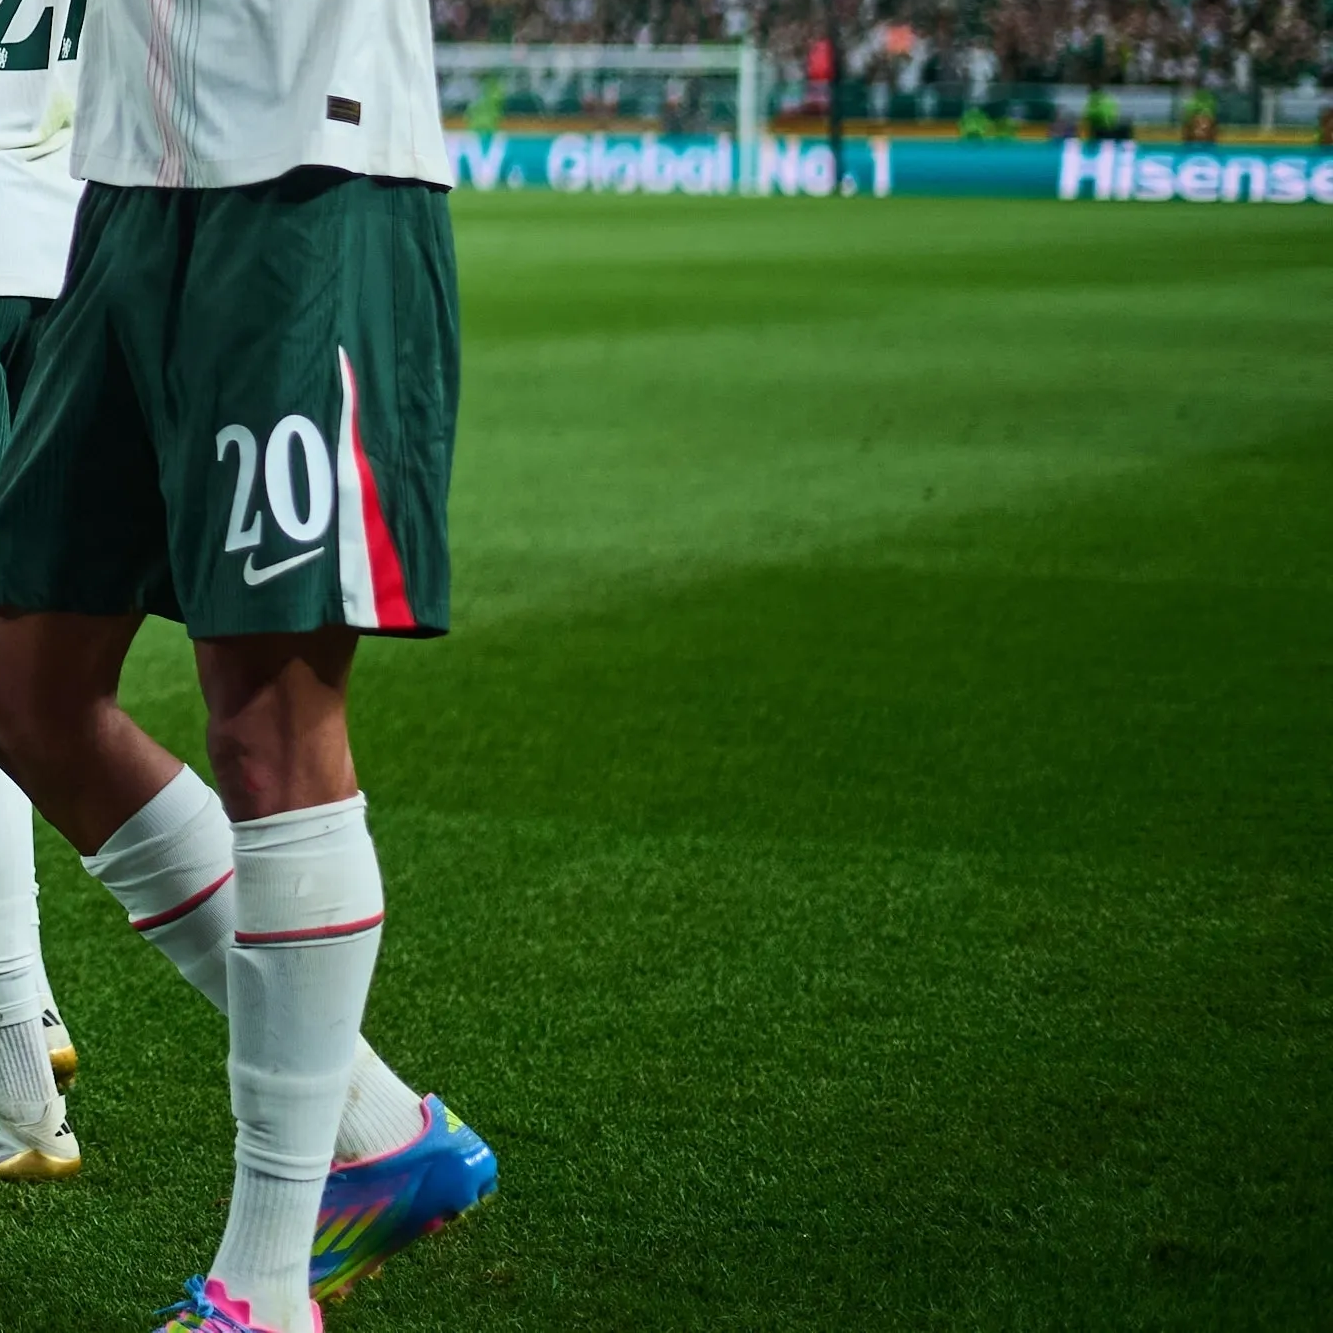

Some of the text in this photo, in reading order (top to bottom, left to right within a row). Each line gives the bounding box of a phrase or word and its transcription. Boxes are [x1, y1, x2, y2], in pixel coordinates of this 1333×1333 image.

[547, 131, 731, 196] Global
[868, 135, 891, 198] 1
[215, 414, 332, 553] 20
